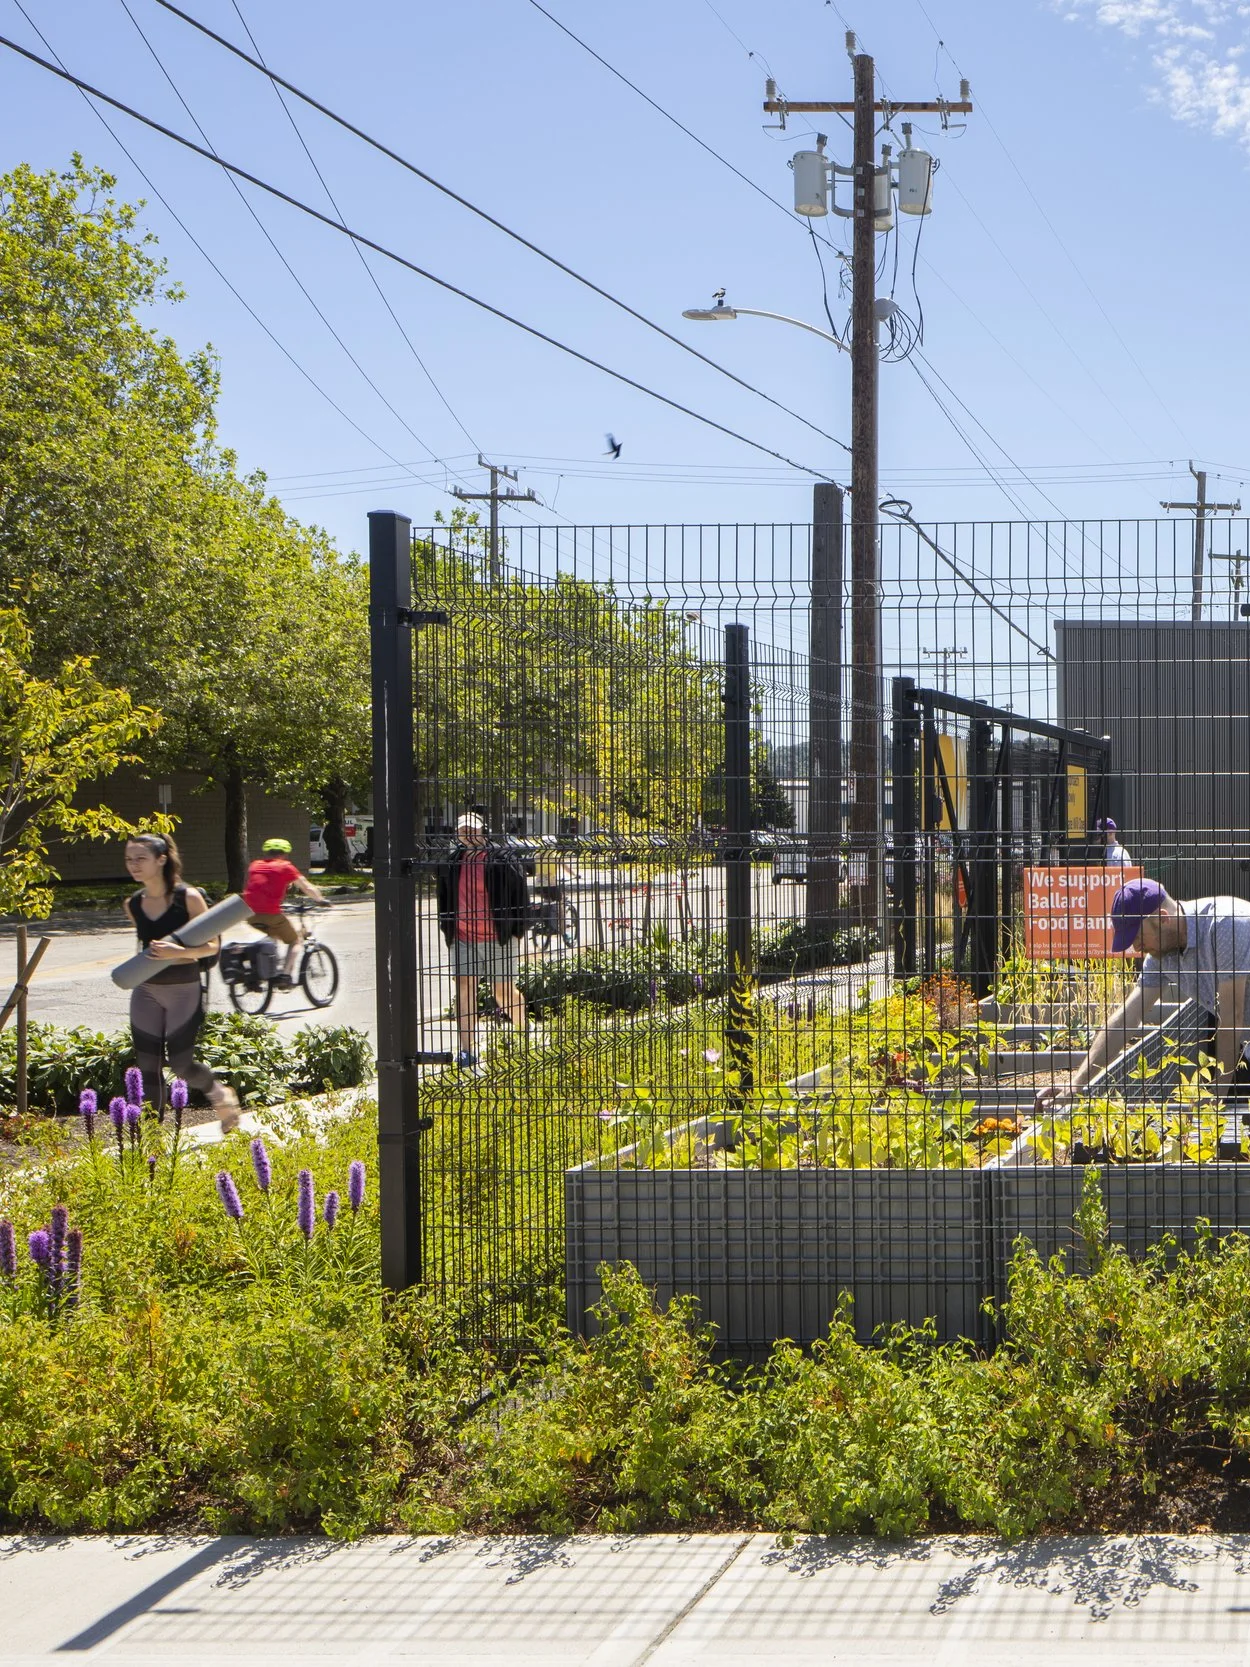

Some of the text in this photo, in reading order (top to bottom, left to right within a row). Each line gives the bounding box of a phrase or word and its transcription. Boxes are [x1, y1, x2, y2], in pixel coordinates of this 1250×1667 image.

[1027, 871, 1126, 891] We support
[1028, 892, 1089, 909] Ballard
[1029, 913, 1068, 930] Food
